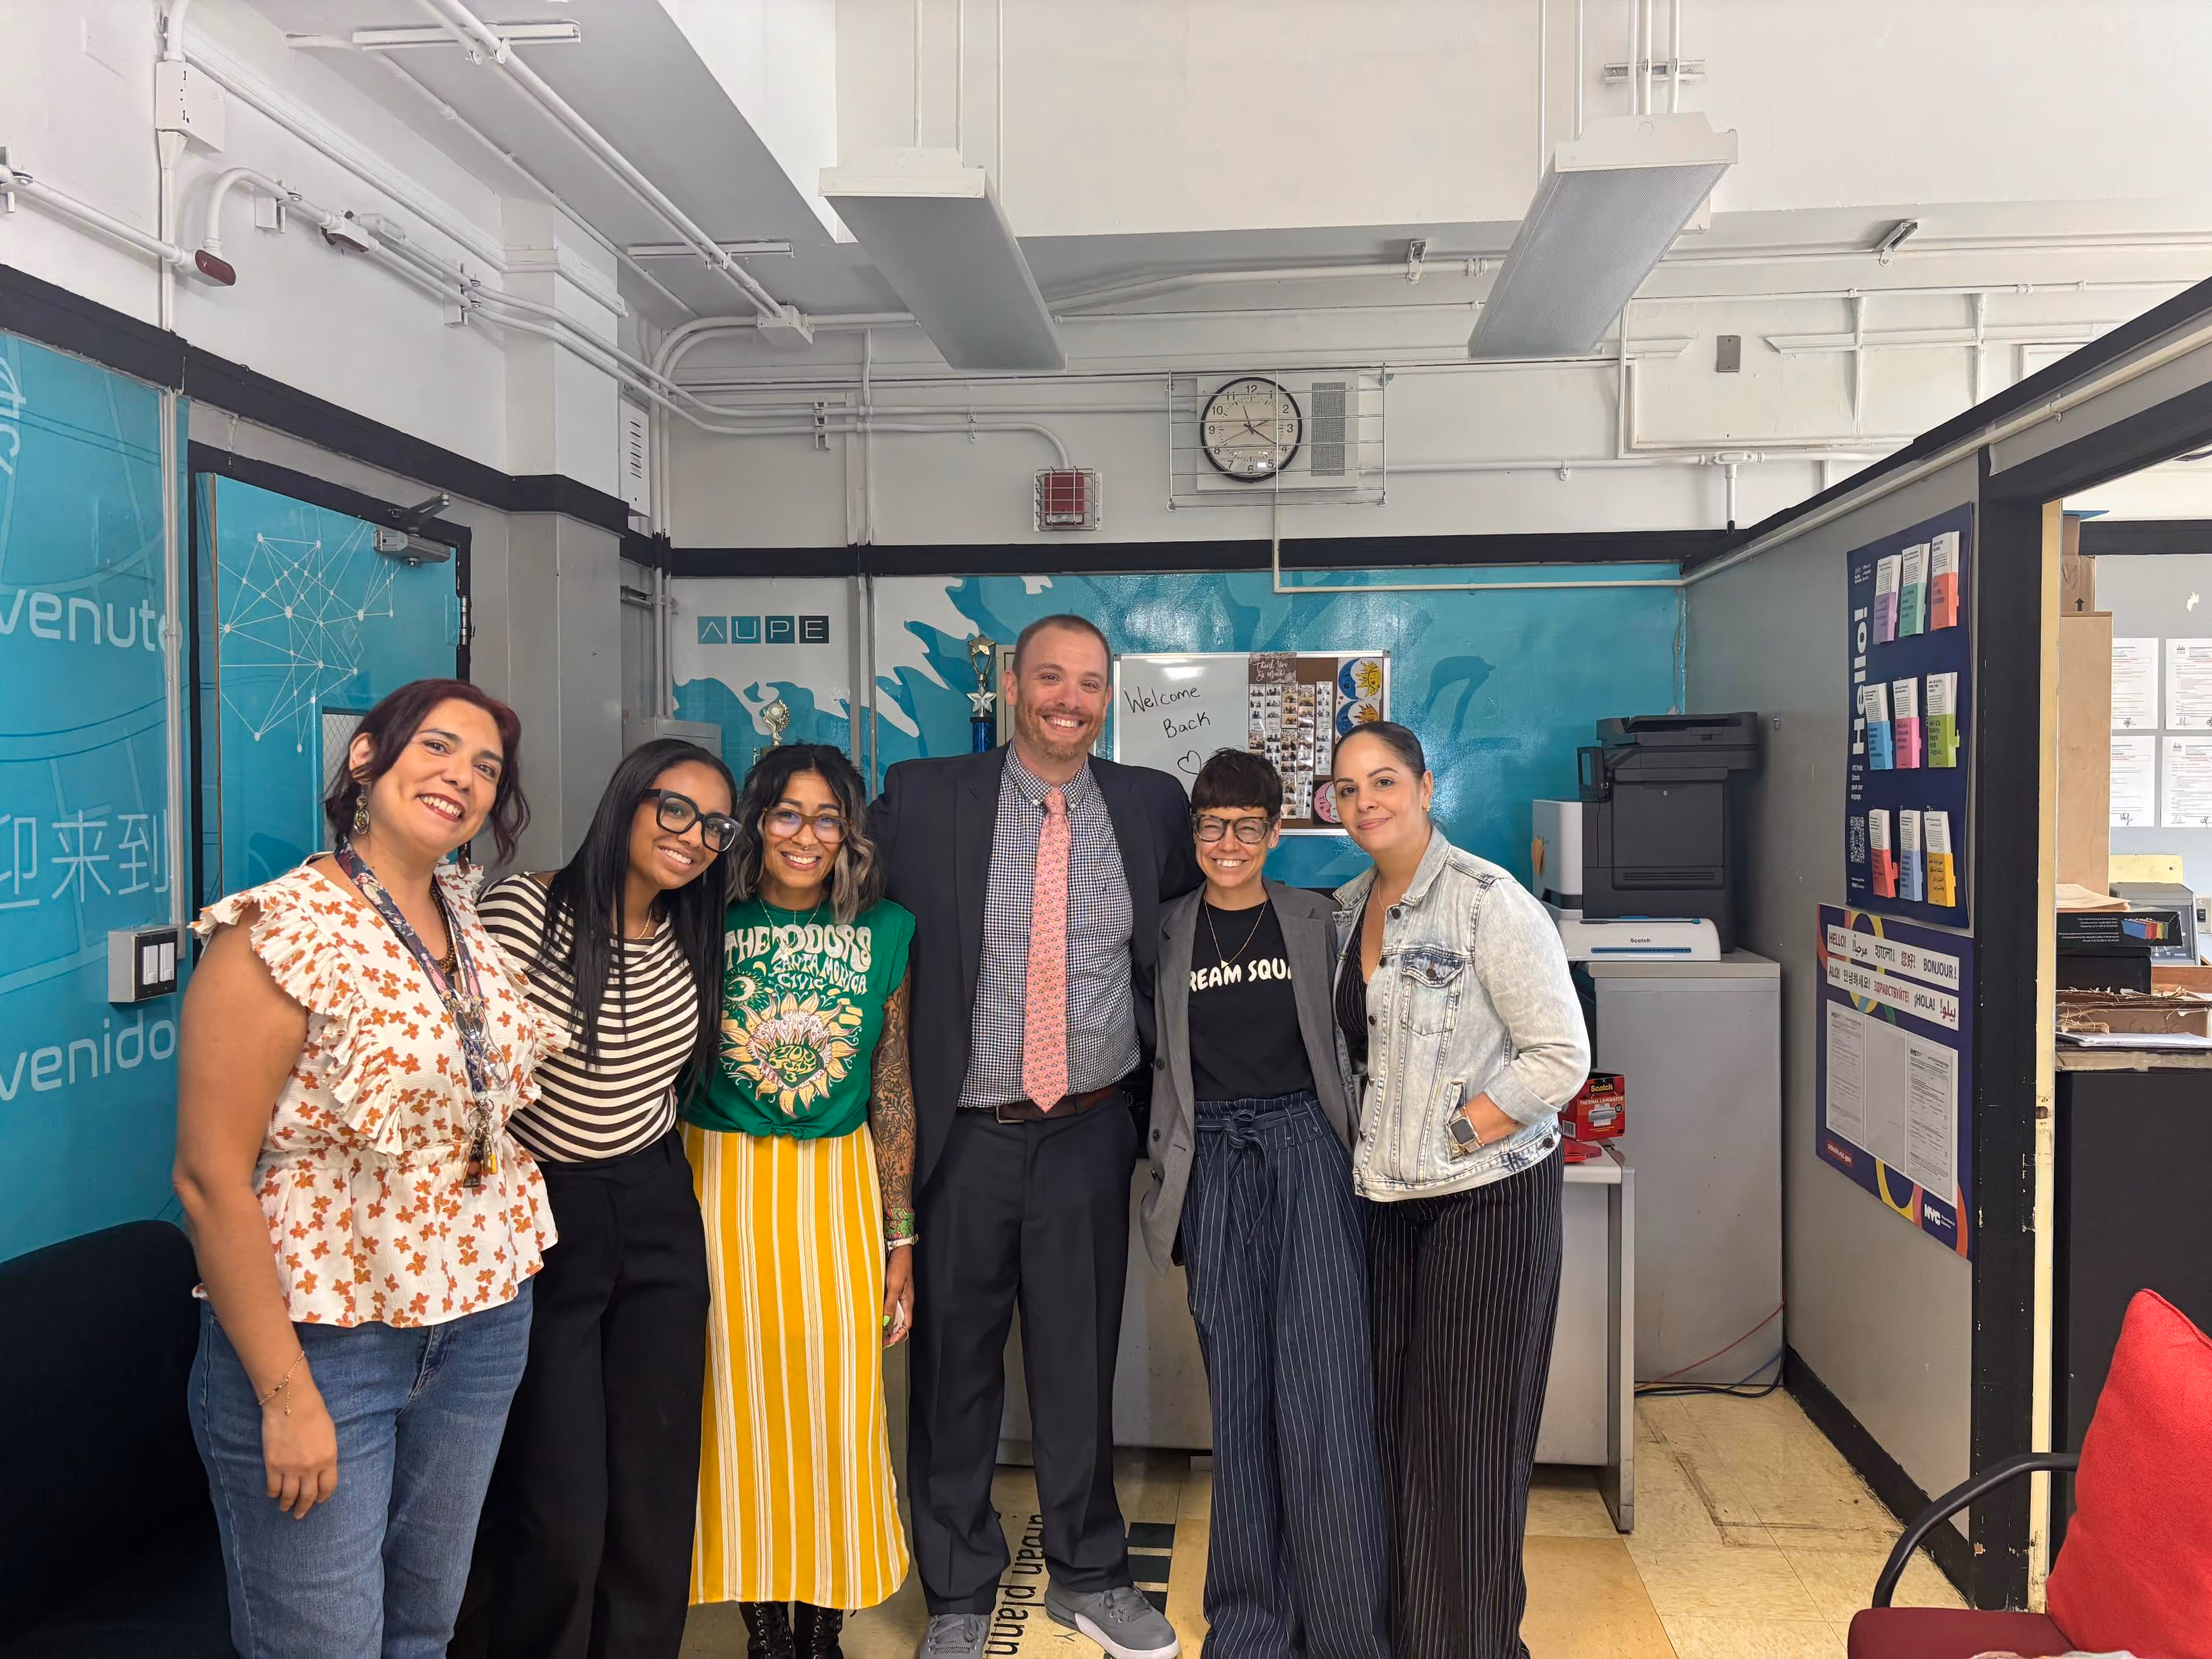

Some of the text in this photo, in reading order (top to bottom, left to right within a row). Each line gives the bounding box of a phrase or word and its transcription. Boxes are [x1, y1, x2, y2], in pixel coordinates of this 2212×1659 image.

[1246, 385, 1257, 393] 12
[1227, 391, 1236, 400] 11
[1211, 406, 1223, 415] 10
[1282, 404, 1290, 414] 2
[1208, 425, 1215, 434] 9
[1286, 424, 1293, 433] 3
[1214, 445, 1221, 455] 8
[1227, 460, 1234, 469] 7
[1267, 459, 1274, 469] 5
[1247, 465, 1254, 474] 6
[701, 620, 823, 640] AUPE
[1853, 606, 1868, 755] Hello!
[1124, 685, 1200, 713] Welcome
[1163, 711, 1211, 738] Back
[1829, 932, 1846, 948] HELLO!
[724, 923, 872, 973] THE DOORS
[769, 953, 868, 996] SANTA MONICA
[778, 973, 828, 991] CIVIC
[1914, 992, 1936, 1011] ¡HOLA!
[1590, 1084, 1613, 1092] Scotch
[1924, 1203, 1941, 1226] NYC
